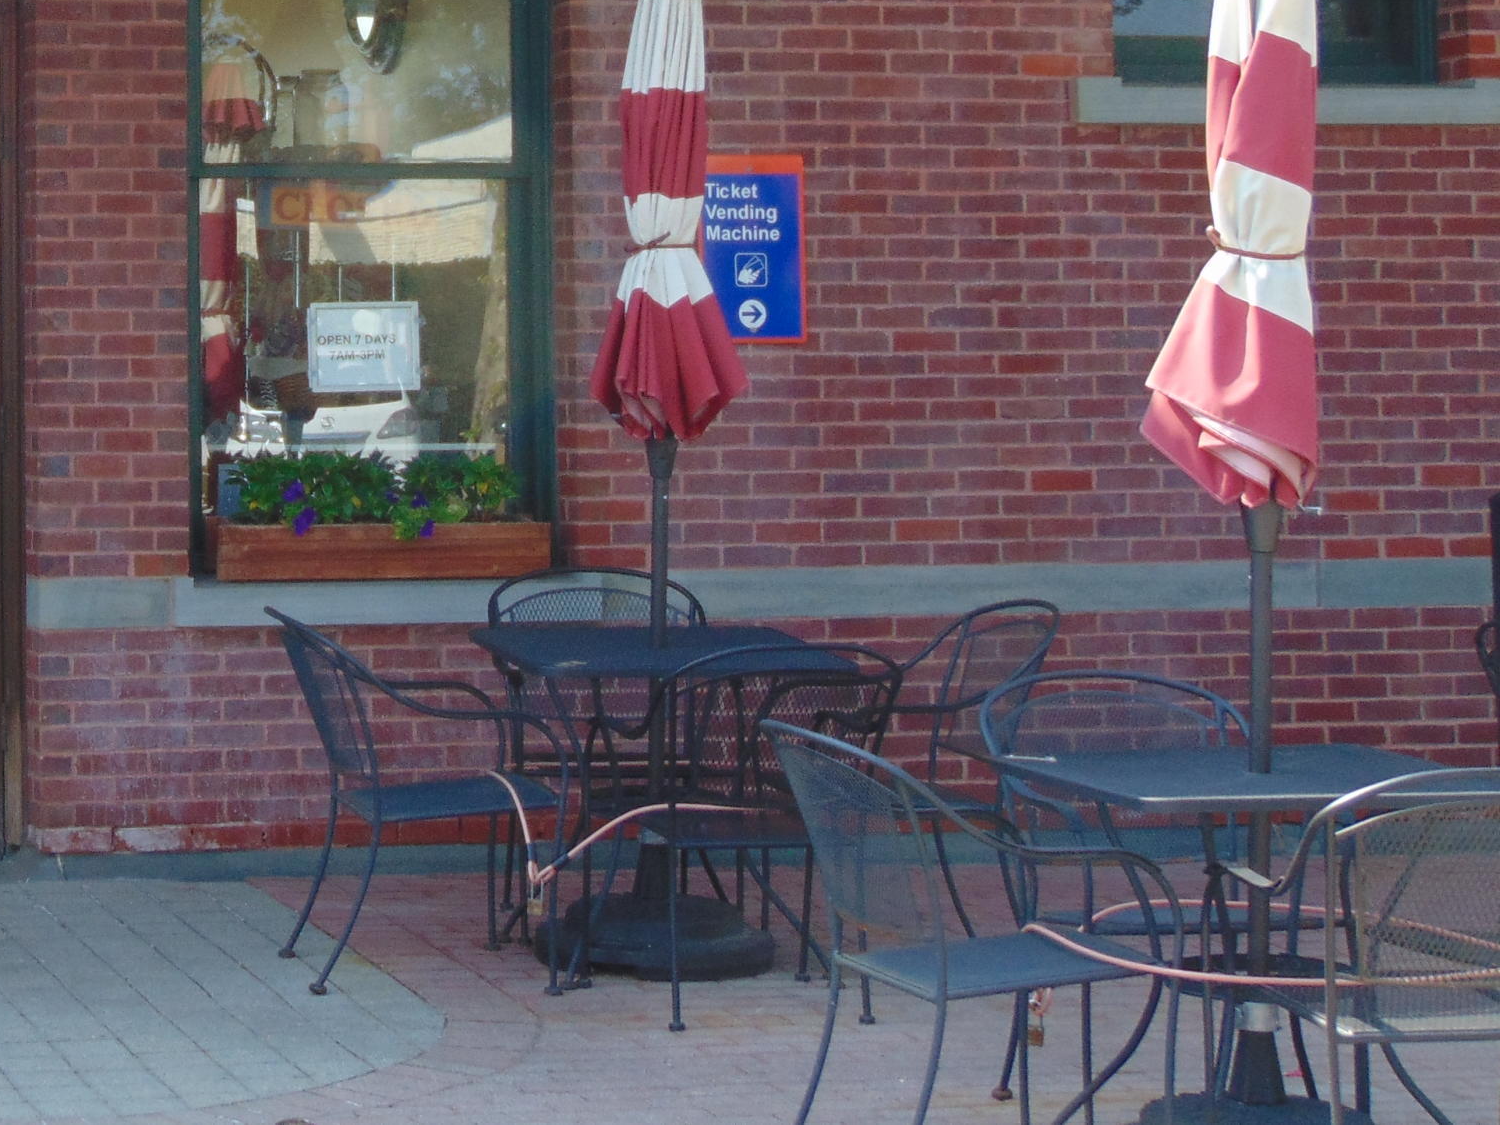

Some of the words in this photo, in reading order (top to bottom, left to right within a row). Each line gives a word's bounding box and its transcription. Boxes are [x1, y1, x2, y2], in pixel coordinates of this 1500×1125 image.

[704, 183, 759, 200] Ticket
[704, 204, 778, 224] Vending
[705, 226, 781, 242] Machine
[317, 335, 352, 346] OPEN
[355, 335, 362, 344] 7
[365, 334, 397, 345] DAYS
